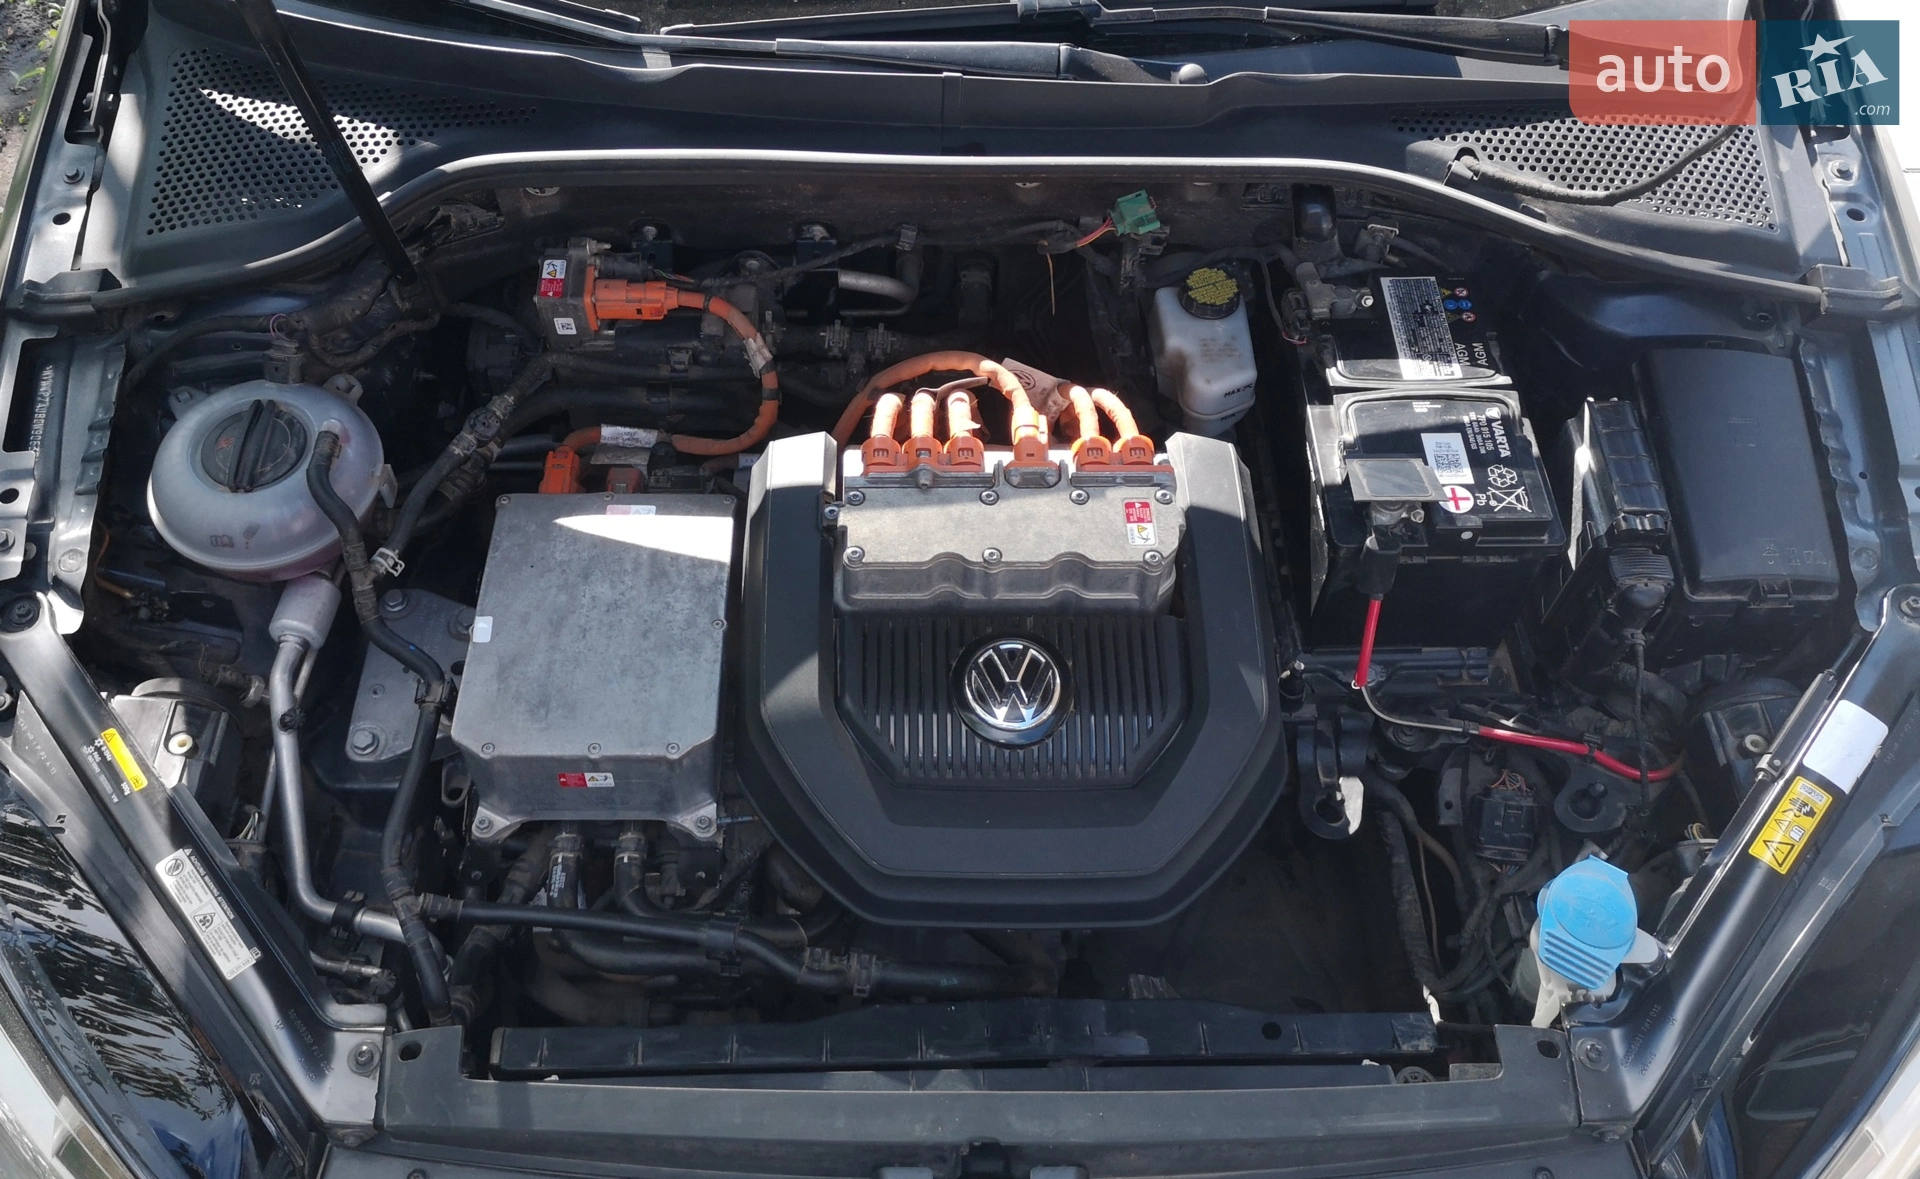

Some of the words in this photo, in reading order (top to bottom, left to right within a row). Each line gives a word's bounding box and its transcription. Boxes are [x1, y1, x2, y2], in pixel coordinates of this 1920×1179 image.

[1454, 342, 1471, 366] AGM
[1472, 342, 1489, 366] AGM
[1223, 387, 1241, 398] MAX
[1480, 425, 1491, 438] 915
[1490, 419, 1511, 458] VARTA
[1483, 438, 1494, 451] 105
[1475, 493, 1487, 506] Pb
[188, 854, 206, 876] ACHTUNG
[202, 874, 220, 897] WARNING
[216, 894, 235, 920] ATTENTION
